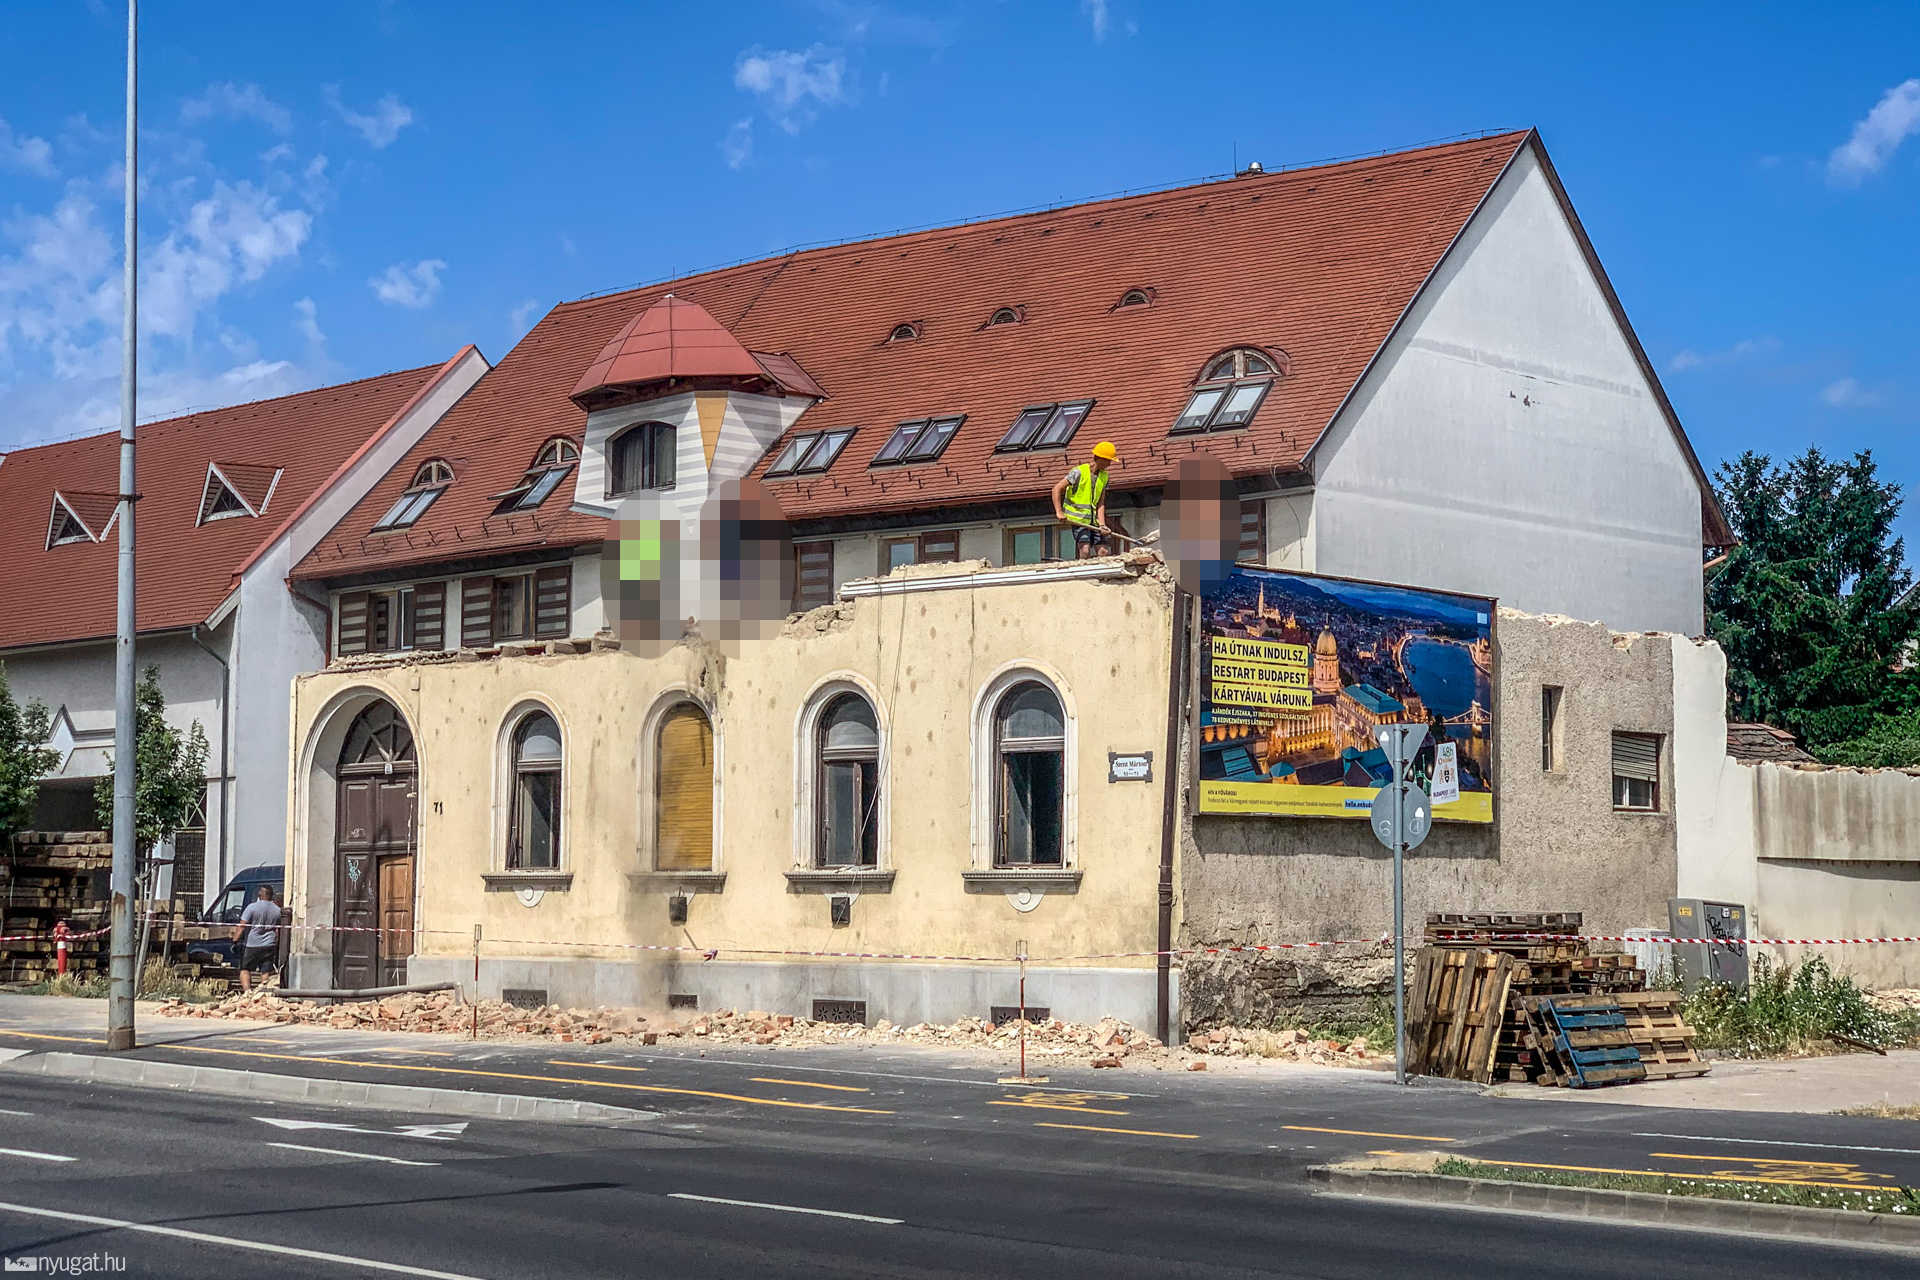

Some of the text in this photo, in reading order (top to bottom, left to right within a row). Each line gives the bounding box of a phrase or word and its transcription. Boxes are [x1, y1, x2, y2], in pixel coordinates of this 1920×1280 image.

[1214, 640, 1307, 665] HA ÚTNAK INDULSZ,
[1213, 664, 1306, 685] RESTART BUDAPEST
[1213, 685, 1311, 707] KÁRTYÁVAL VÁRUNK.
